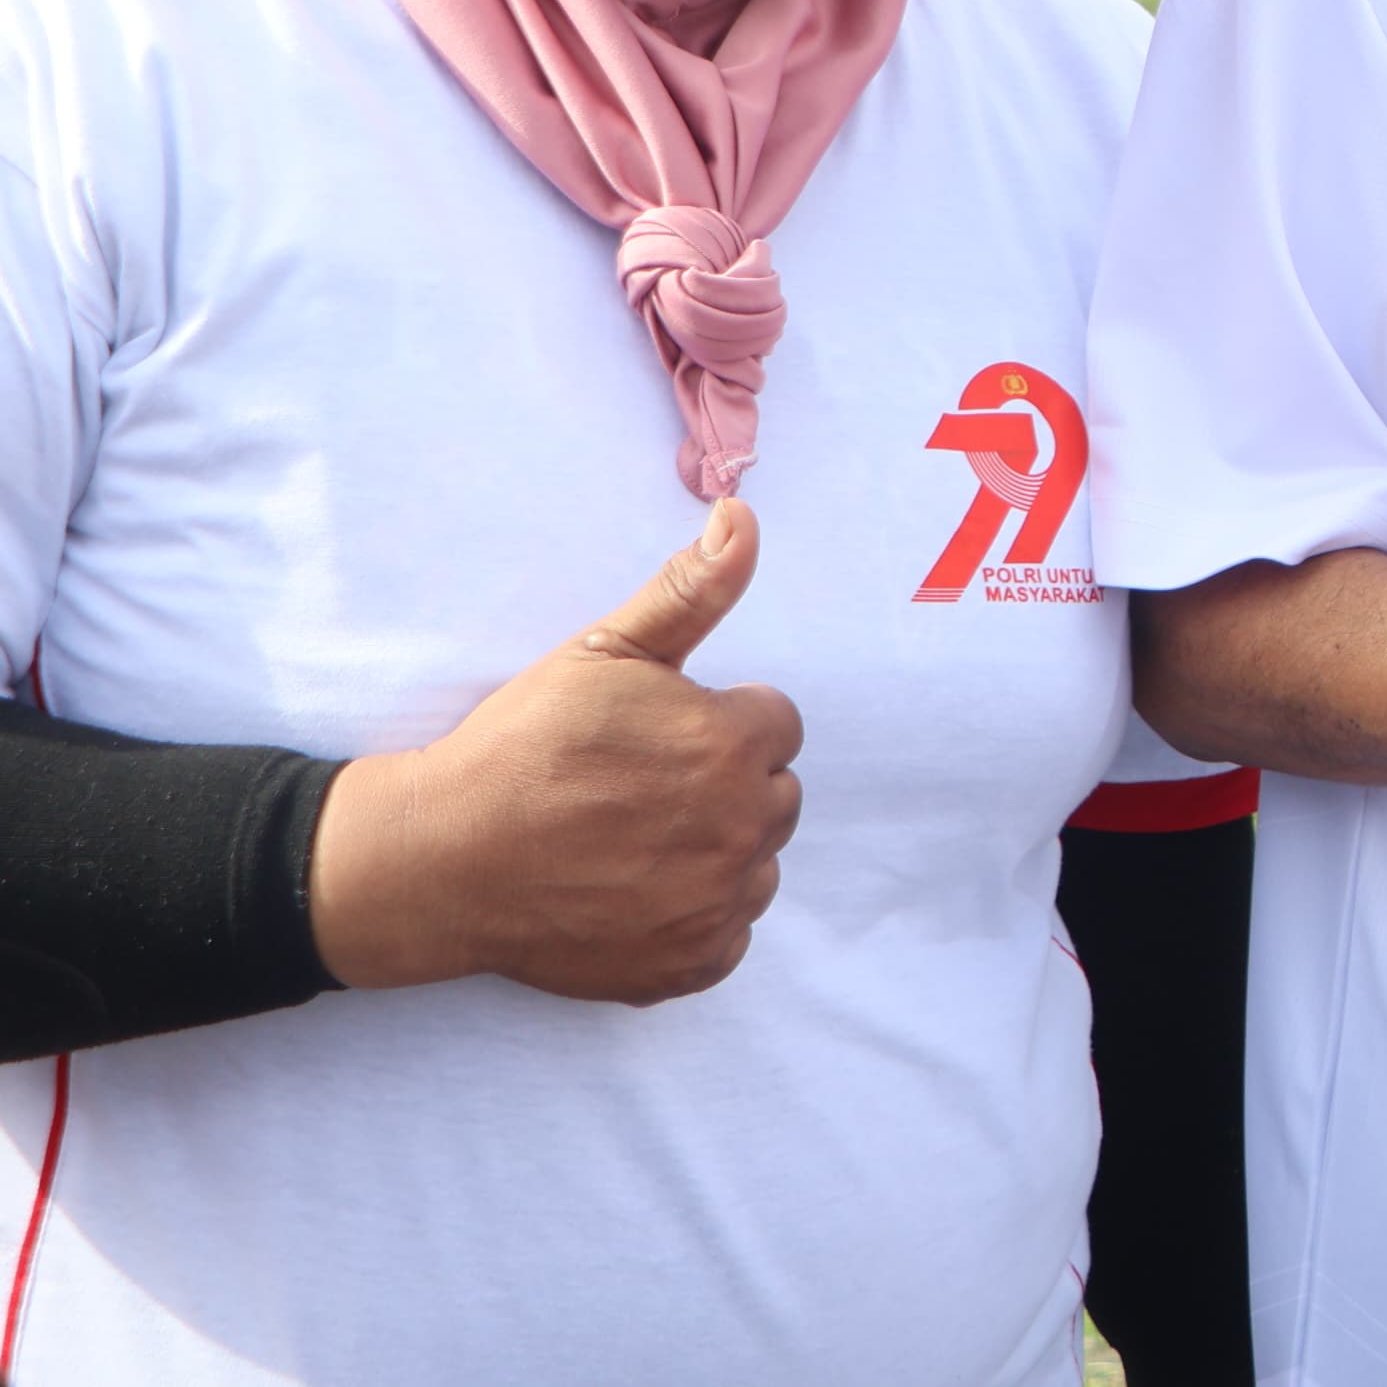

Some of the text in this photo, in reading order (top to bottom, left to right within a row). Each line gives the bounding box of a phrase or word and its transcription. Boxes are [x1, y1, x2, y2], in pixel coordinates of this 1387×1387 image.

[982, 567, 1095, 584] POLRI UNTU
[985, 586, 1105, 603] MASYARAKAT
